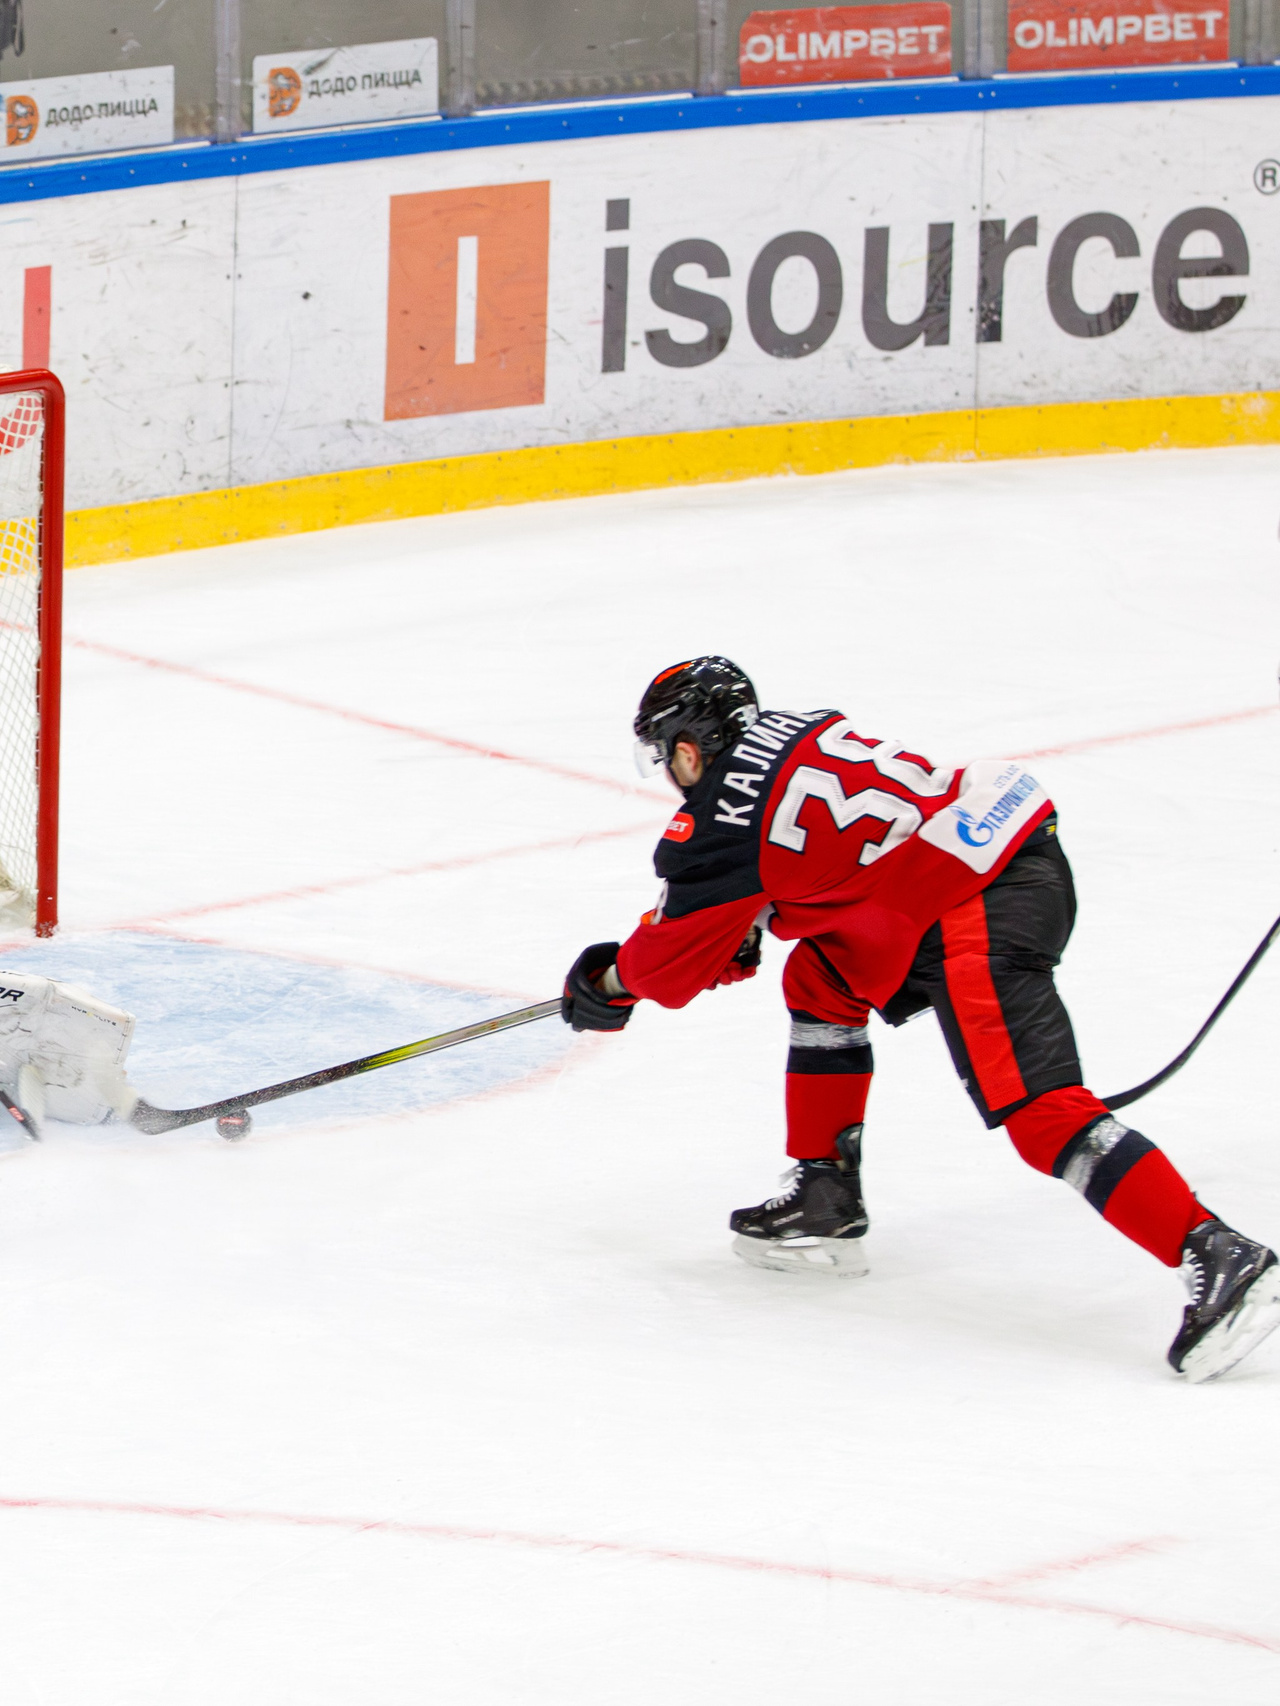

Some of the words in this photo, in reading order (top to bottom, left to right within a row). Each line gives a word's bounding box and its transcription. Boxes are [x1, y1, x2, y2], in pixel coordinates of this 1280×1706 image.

[746, 26, 944, 62] OLIMPBET
[1015, 12, 1222, 48] OLIMPBET
[308, 75, 358, 98] ДОДО
[362, 69, 422, 90] ПИЦЦА
[45, 103, 95, 127] ДОДО
[98, 97, 158, 118] ПИЦЦА
[600, 198, 1250, 373] isource
[714, 710, 826, 826] КАЛИН
[768, 717, 956, 866] 38
